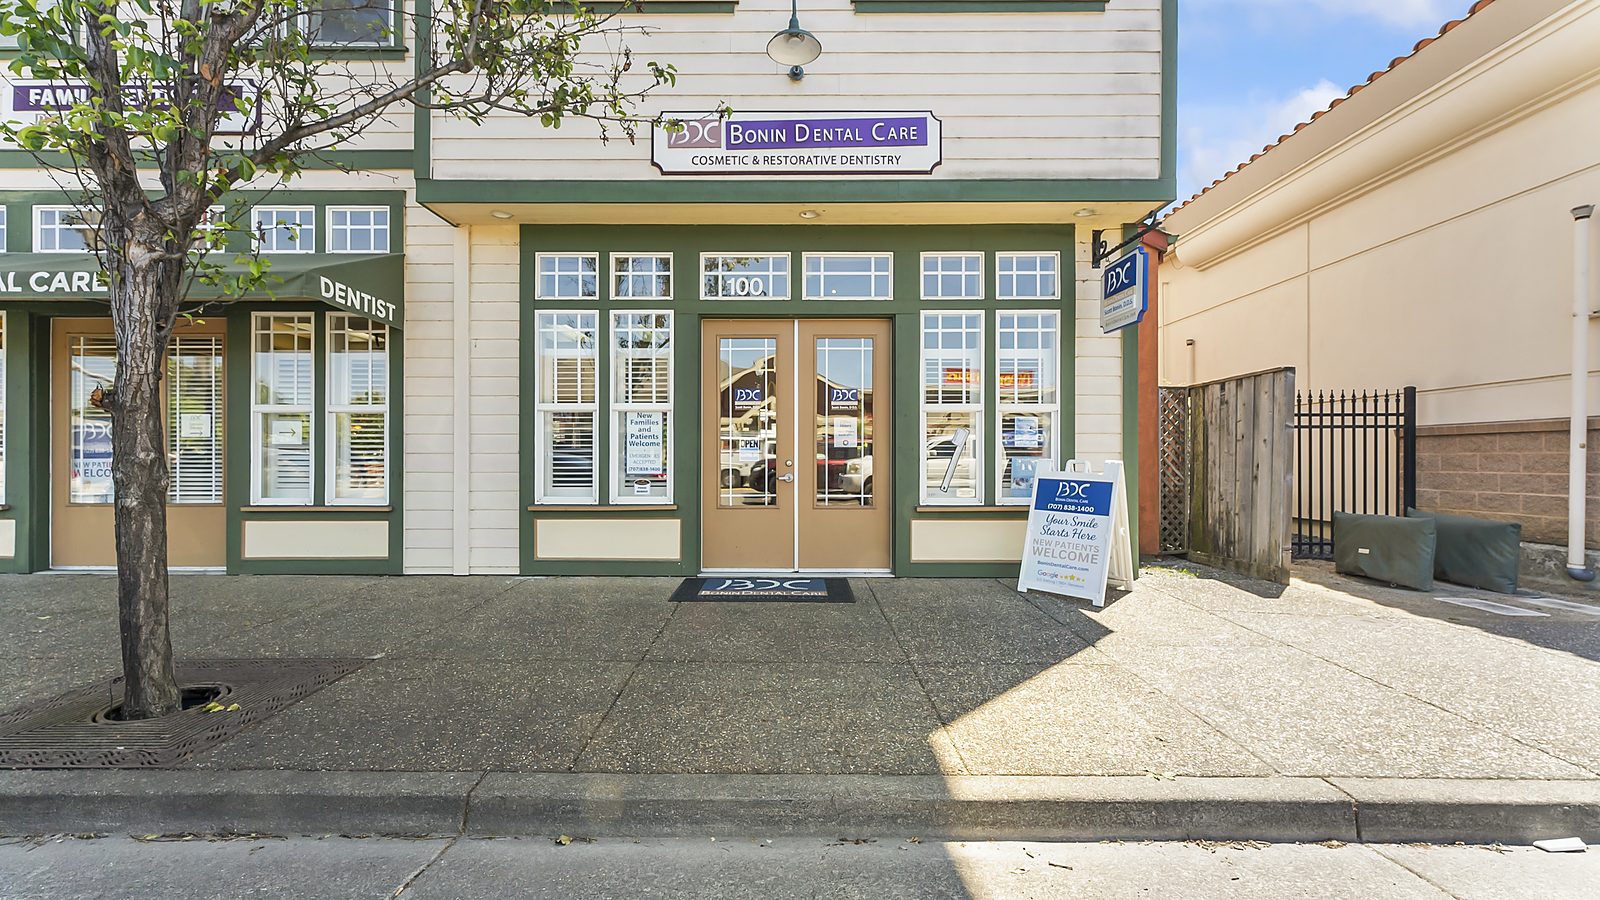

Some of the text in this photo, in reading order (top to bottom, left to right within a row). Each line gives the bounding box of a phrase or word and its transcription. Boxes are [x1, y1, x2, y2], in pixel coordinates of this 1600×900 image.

[29, 88, 91, 106] FAMIL
[730, 121, 918, 145] BONIN DENTAL CARE
[691, 154, 902, 166] COSMETIC & RESTORATIVE DENTISTRY
[29, 271, 108, 293] CARE
[726, 277, 763, 296] 100
[320, 275, 396, 321] DENTIST
[736, 389, 761, 401] BDC
[832, 389, 857, 401] BDC
[741, 439, 759, 448] OPEN
[1056, 481, 1091, 498] BDC
[1047, 503, 1063, 511] (707)
[1045, 513, 1099, 529] Your Smile
[1039, 524, 1097, 541] Starts Here
[1032, 538, 1100, 553] NEW PATIENTS
[1032, 546, 1099, 565] WELCOME
[1037, 569, 1059, 579] Google
